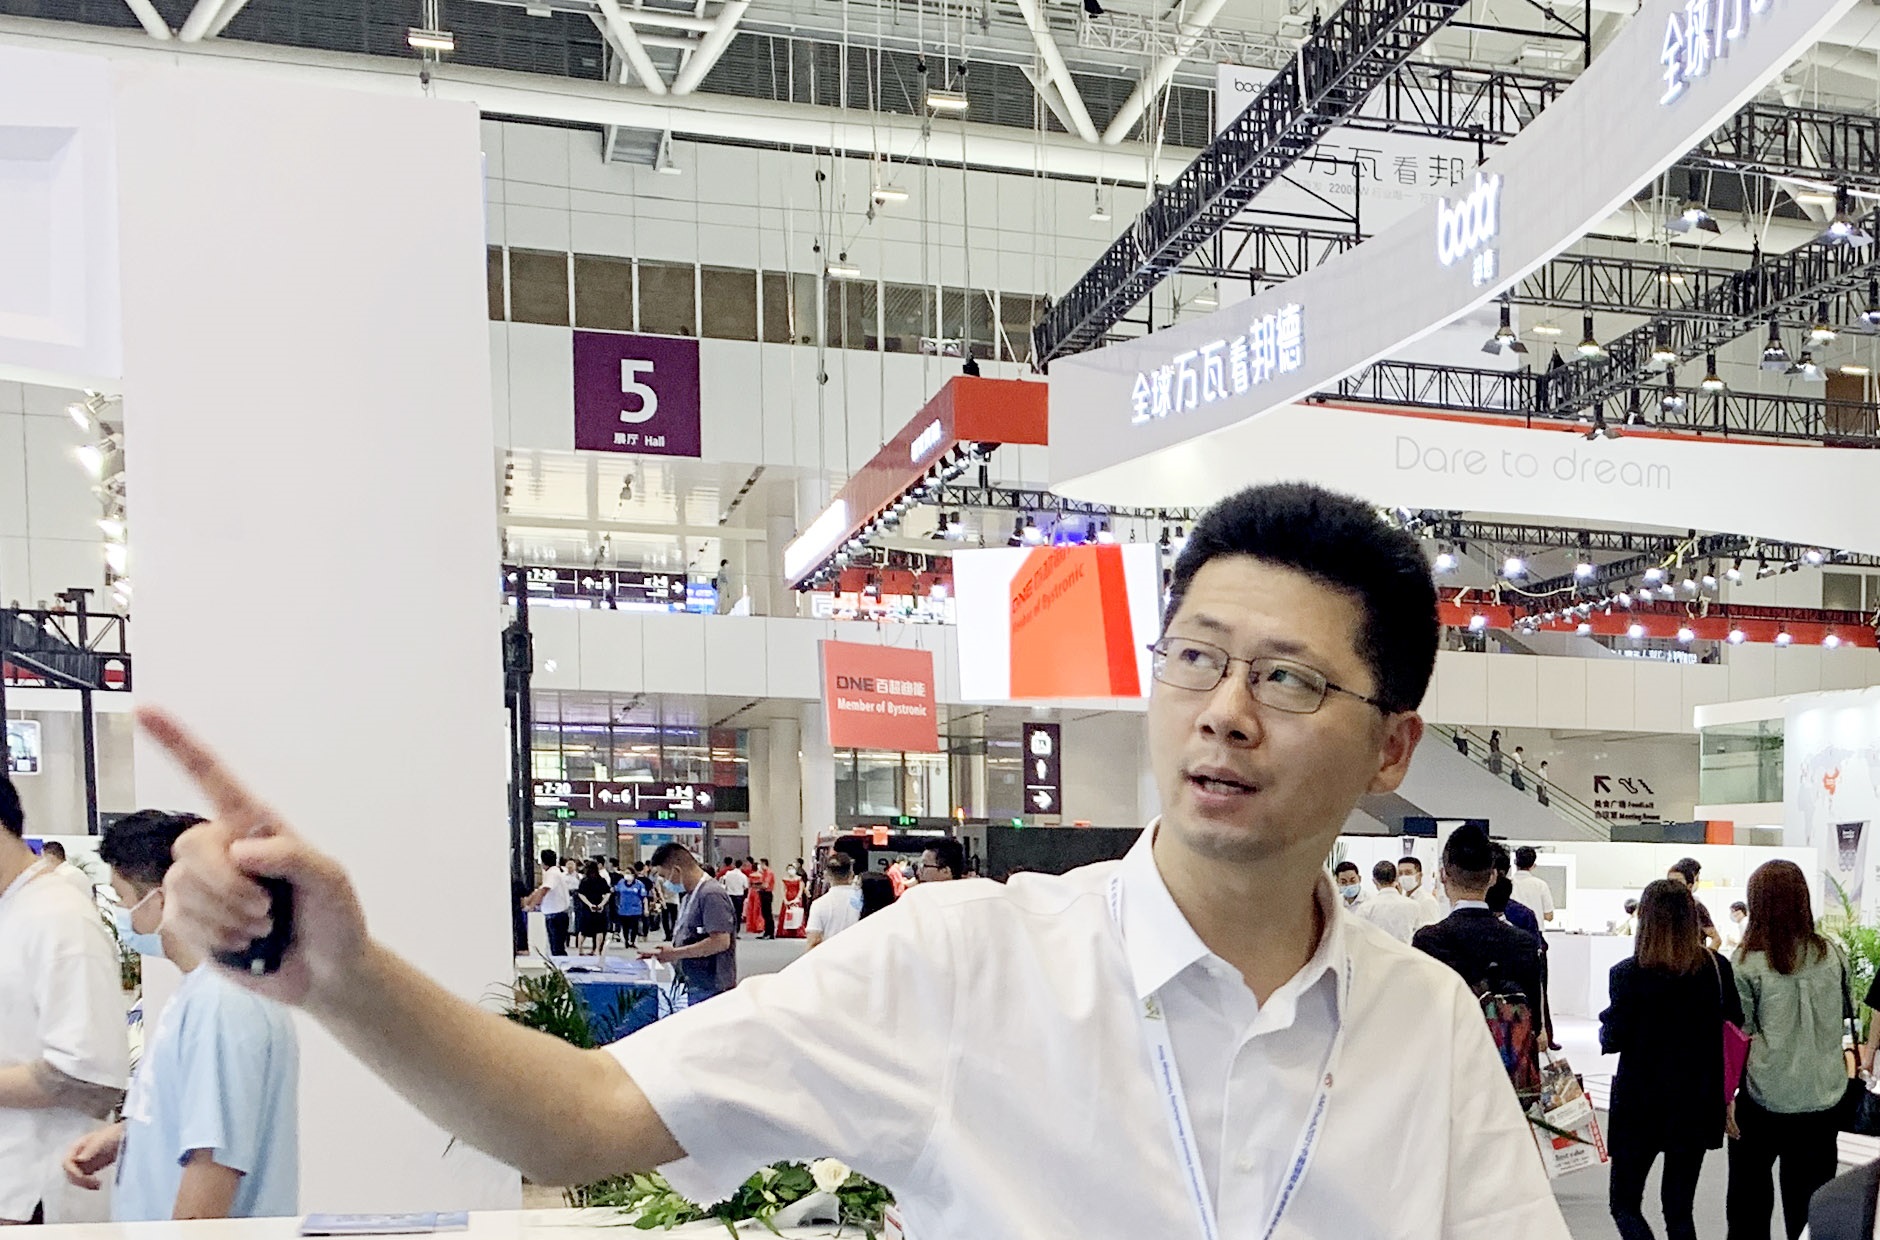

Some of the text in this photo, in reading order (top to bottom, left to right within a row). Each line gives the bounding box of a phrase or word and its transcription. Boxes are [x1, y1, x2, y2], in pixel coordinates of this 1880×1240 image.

[1438, 171, 1499, 265] bodor
[1131, 303, 1302, 424] 全球万瓦看邦德
[620, 359, 658, 423] 5
[644, 435, 665, 447] Hall
[1395, 436, 1671, 489] Dare to dream
[837, 697, 927, 717] Member of Bystronic
[1619, 812, 1642, 821] Meeting
